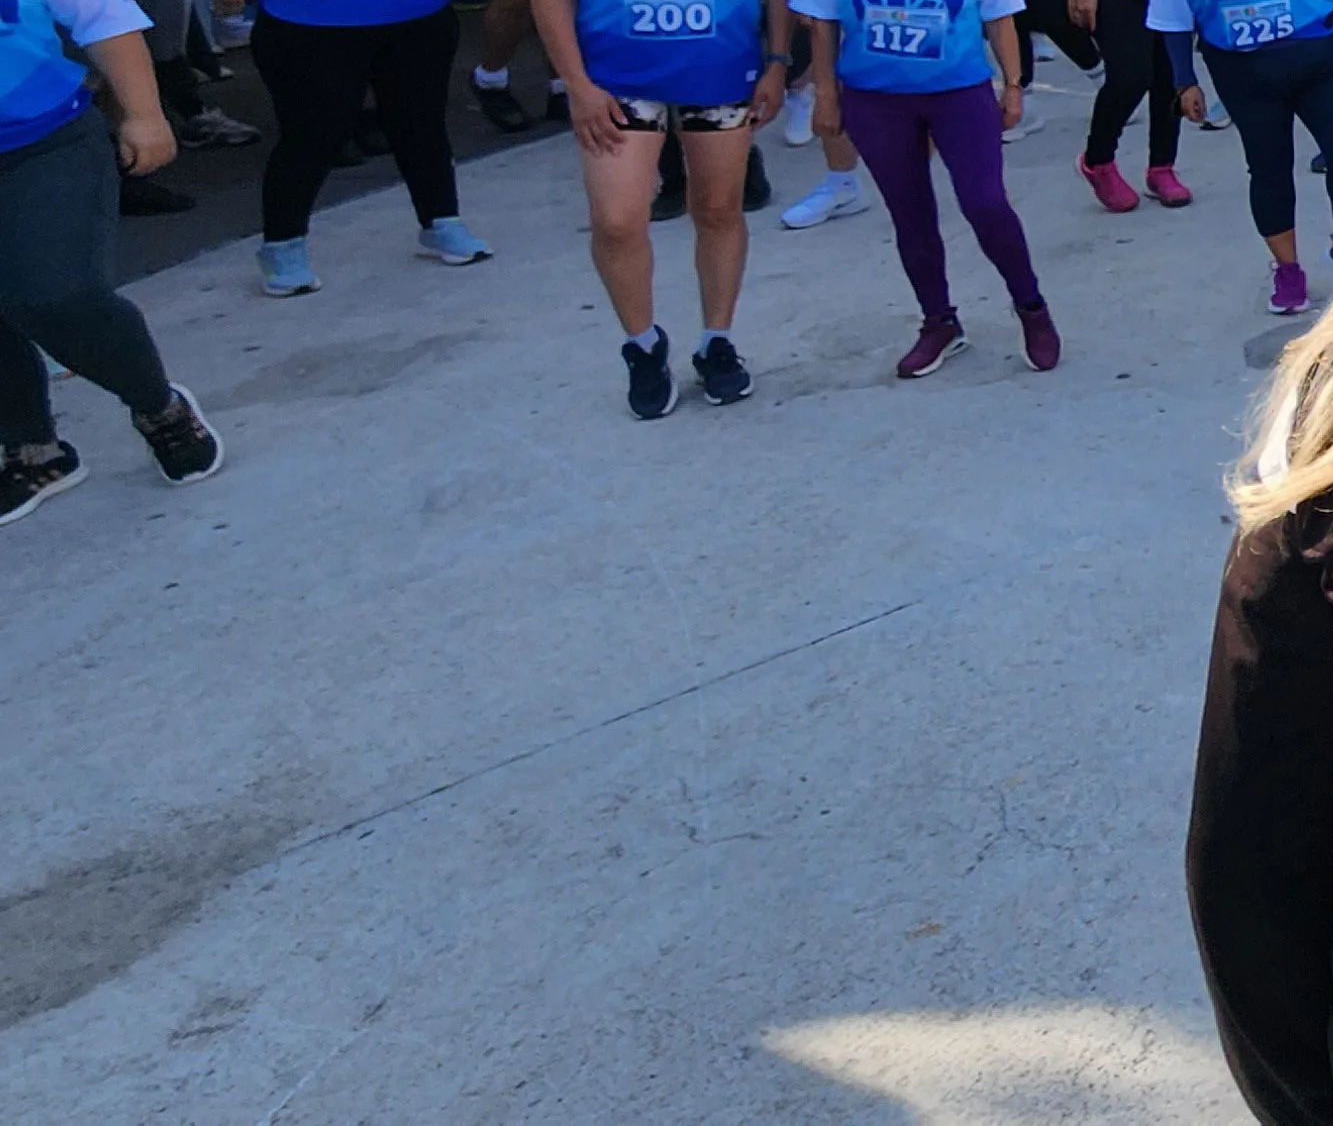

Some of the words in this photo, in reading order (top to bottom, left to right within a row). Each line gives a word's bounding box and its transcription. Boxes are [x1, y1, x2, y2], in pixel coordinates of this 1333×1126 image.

[631, 3, 711, 32] 200
[1232, 14, 1294, 46] 225
[871, 24, 927, 53] 117
